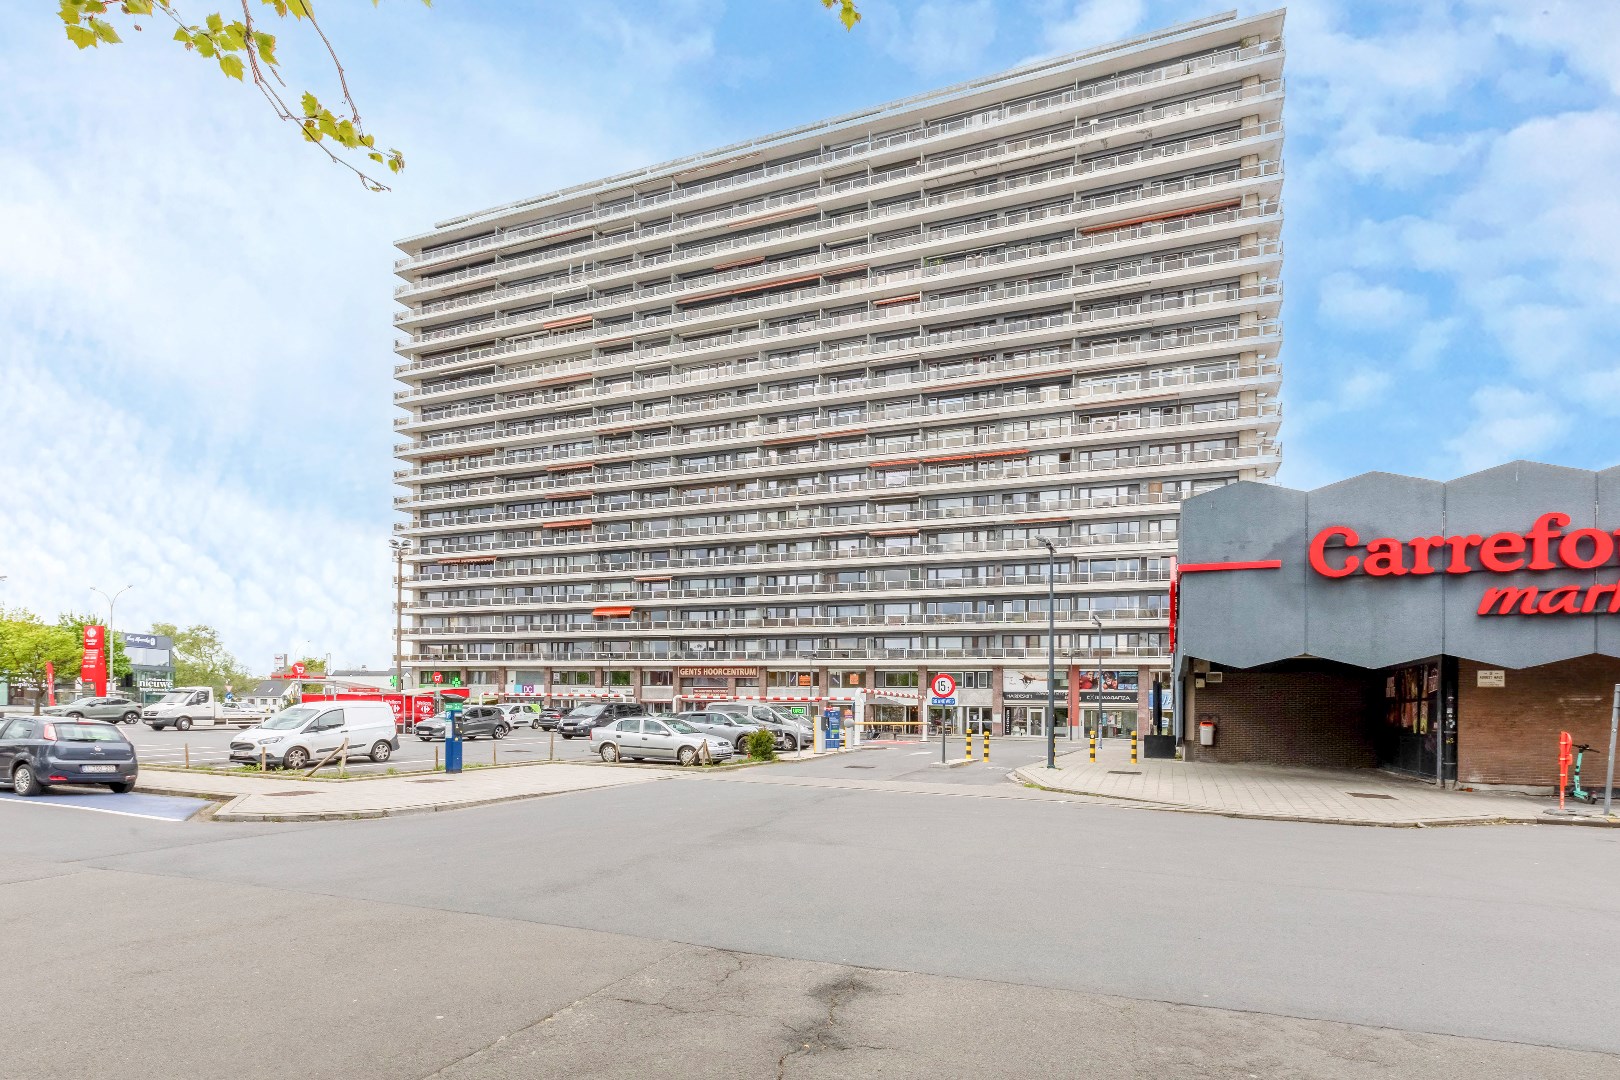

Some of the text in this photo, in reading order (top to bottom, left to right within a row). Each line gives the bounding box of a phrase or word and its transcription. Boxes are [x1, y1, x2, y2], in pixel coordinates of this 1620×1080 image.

[1308, 512, 1620, 578] Carrefo
[680, 668, 757, 676] GENTS HOORCENTRUM
[523, 685, 533, 693] DC
[937, 680, 946, 691] 15
